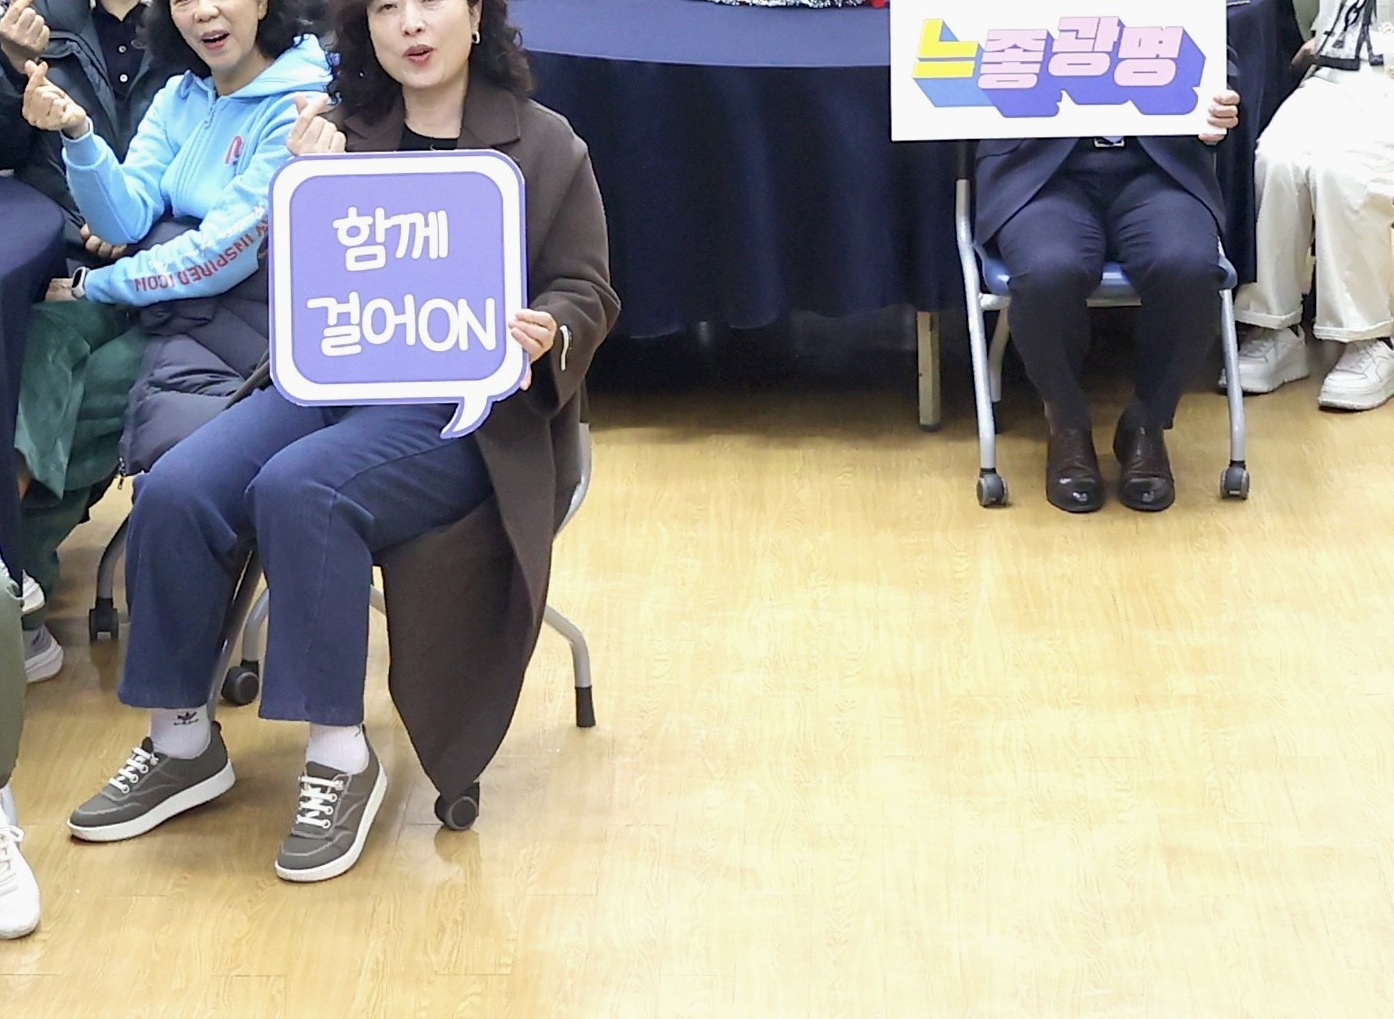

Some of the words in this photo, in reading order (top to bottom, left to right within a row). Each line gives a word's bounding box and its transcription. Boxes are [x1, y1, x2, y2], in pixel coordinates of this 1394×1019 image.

[911, 16, 1205, 119] 느좋광명
[333, 206, 448, 271] 함께
[307, 297, 497, 357] 걸어ON
